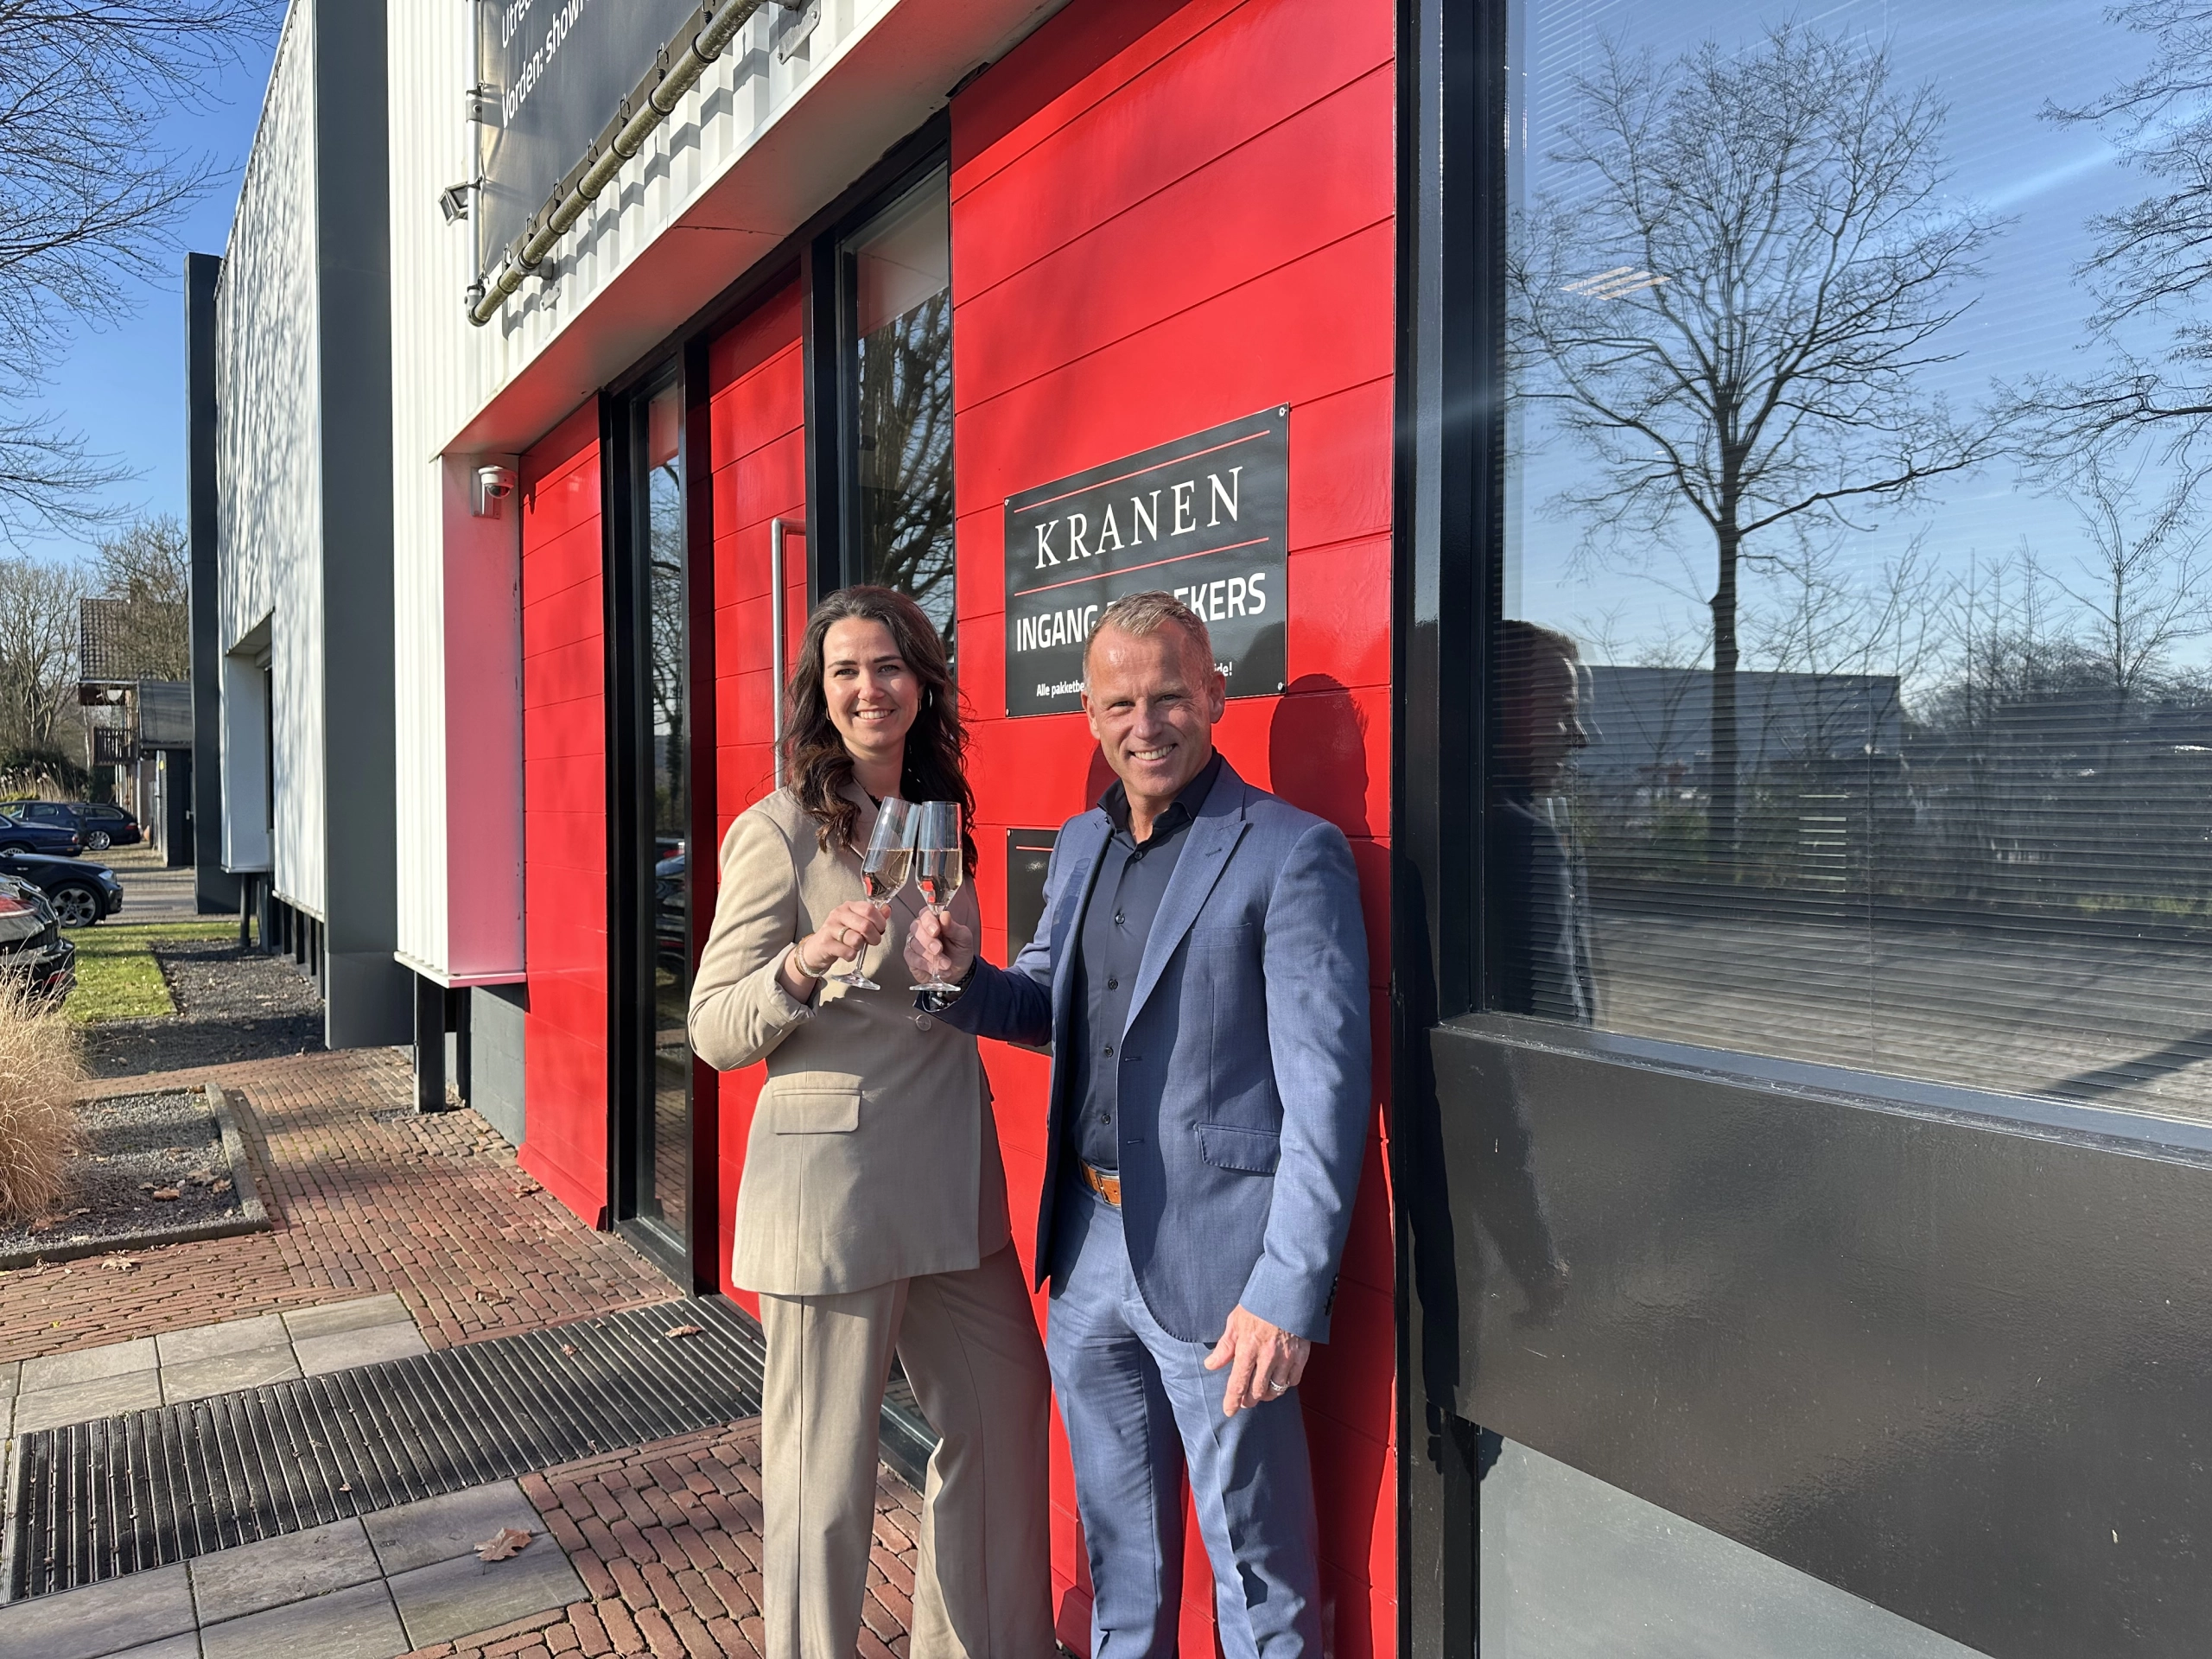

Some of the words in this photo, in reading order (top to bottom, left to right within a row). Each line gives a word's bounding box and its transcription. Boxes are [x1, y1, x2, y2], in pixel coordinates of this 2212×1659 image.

[502, 47, 543, 129] Vorden:
[1034, 466, 1243, 569] KRANEN
[1017, 604, 1098, 652] INGANG
[1036, 683, 1051, 696] Alle
